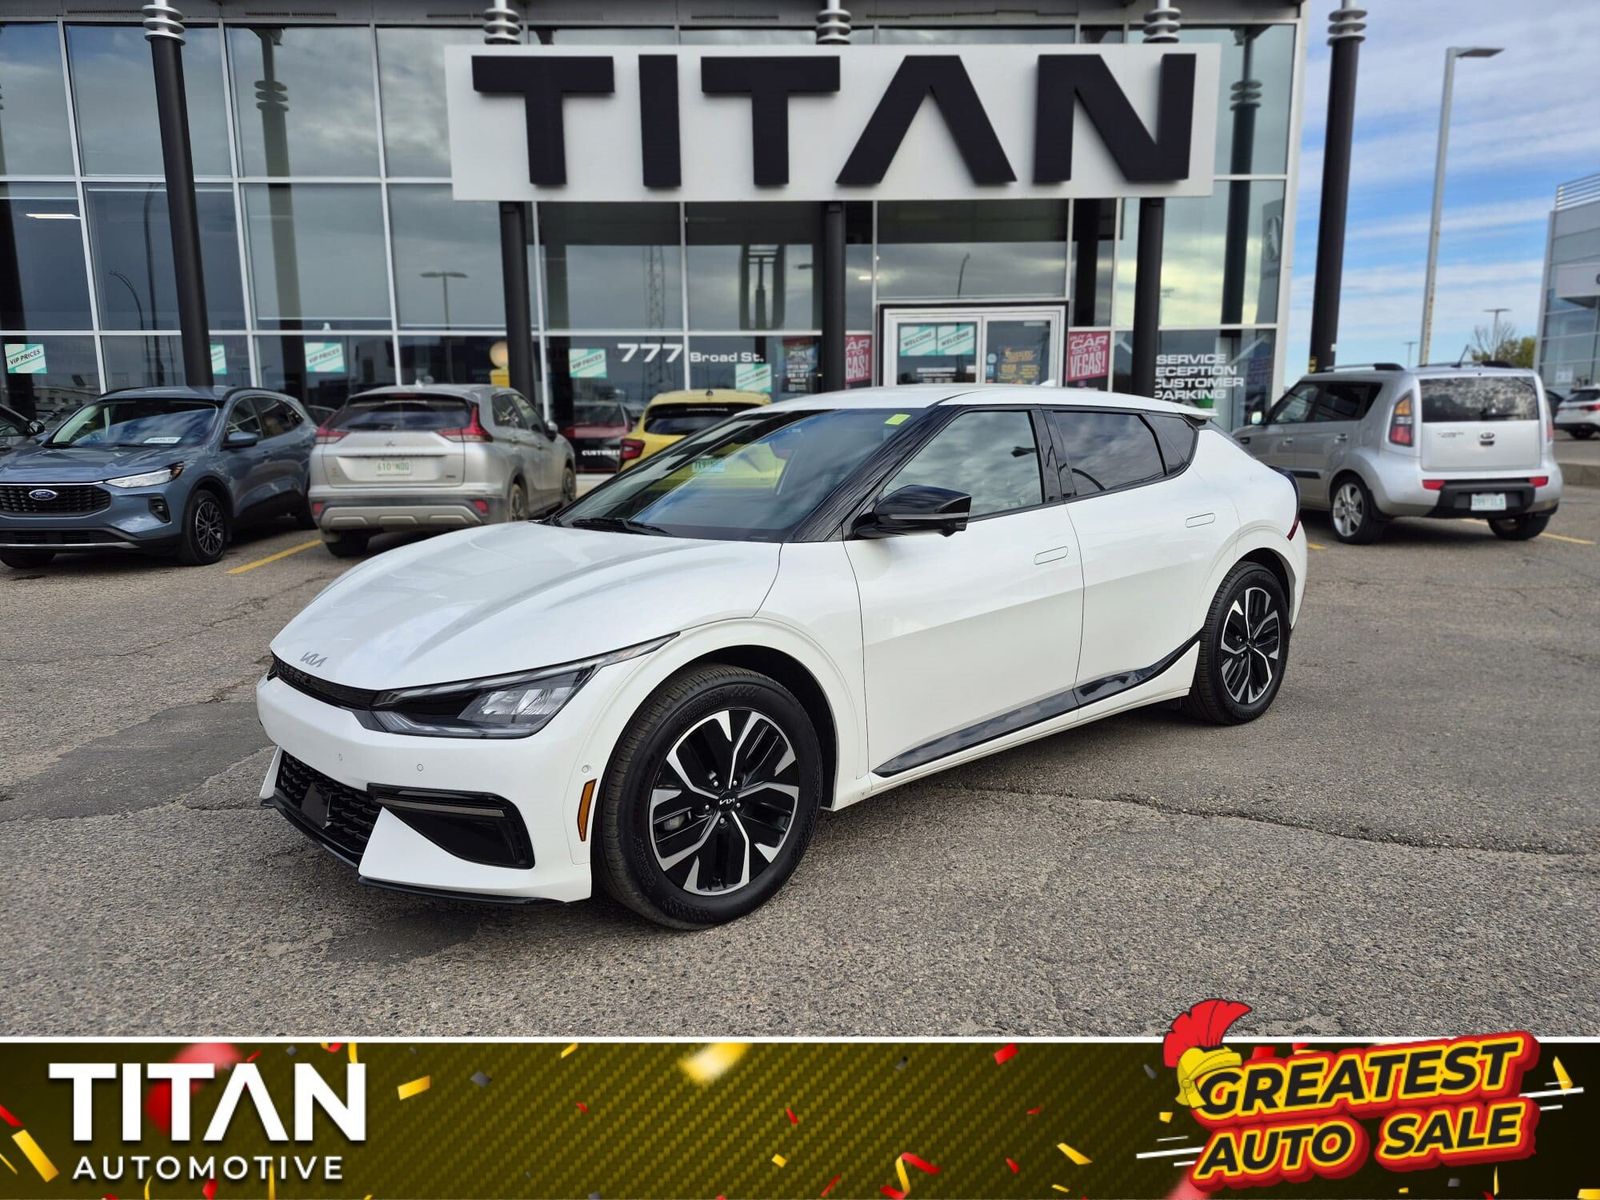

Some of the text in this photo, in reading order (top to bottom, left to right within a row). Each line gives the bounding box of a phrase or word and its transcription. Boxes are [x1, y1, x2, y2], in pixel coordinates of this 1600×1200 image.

[471, 54, 1196, 188] TITAN
[846, 340, 870, 351] AR
[904, 331, 932, 347] WELCOME
[941, 331, 969, 347] WELCOME
[1071, 336, 1109, 350] CAR
[10, 349, 41, 365] VIP PRICES
[617, 343, 765, 362] 777 Broad St.
[1156, 353, 1227, 365] SERVICE
[846, 354, 869, 379] GAS!
[1070, 350, 1106, 377] VEGAS!
[1155, 365, 1237, 377] ECEPTION
